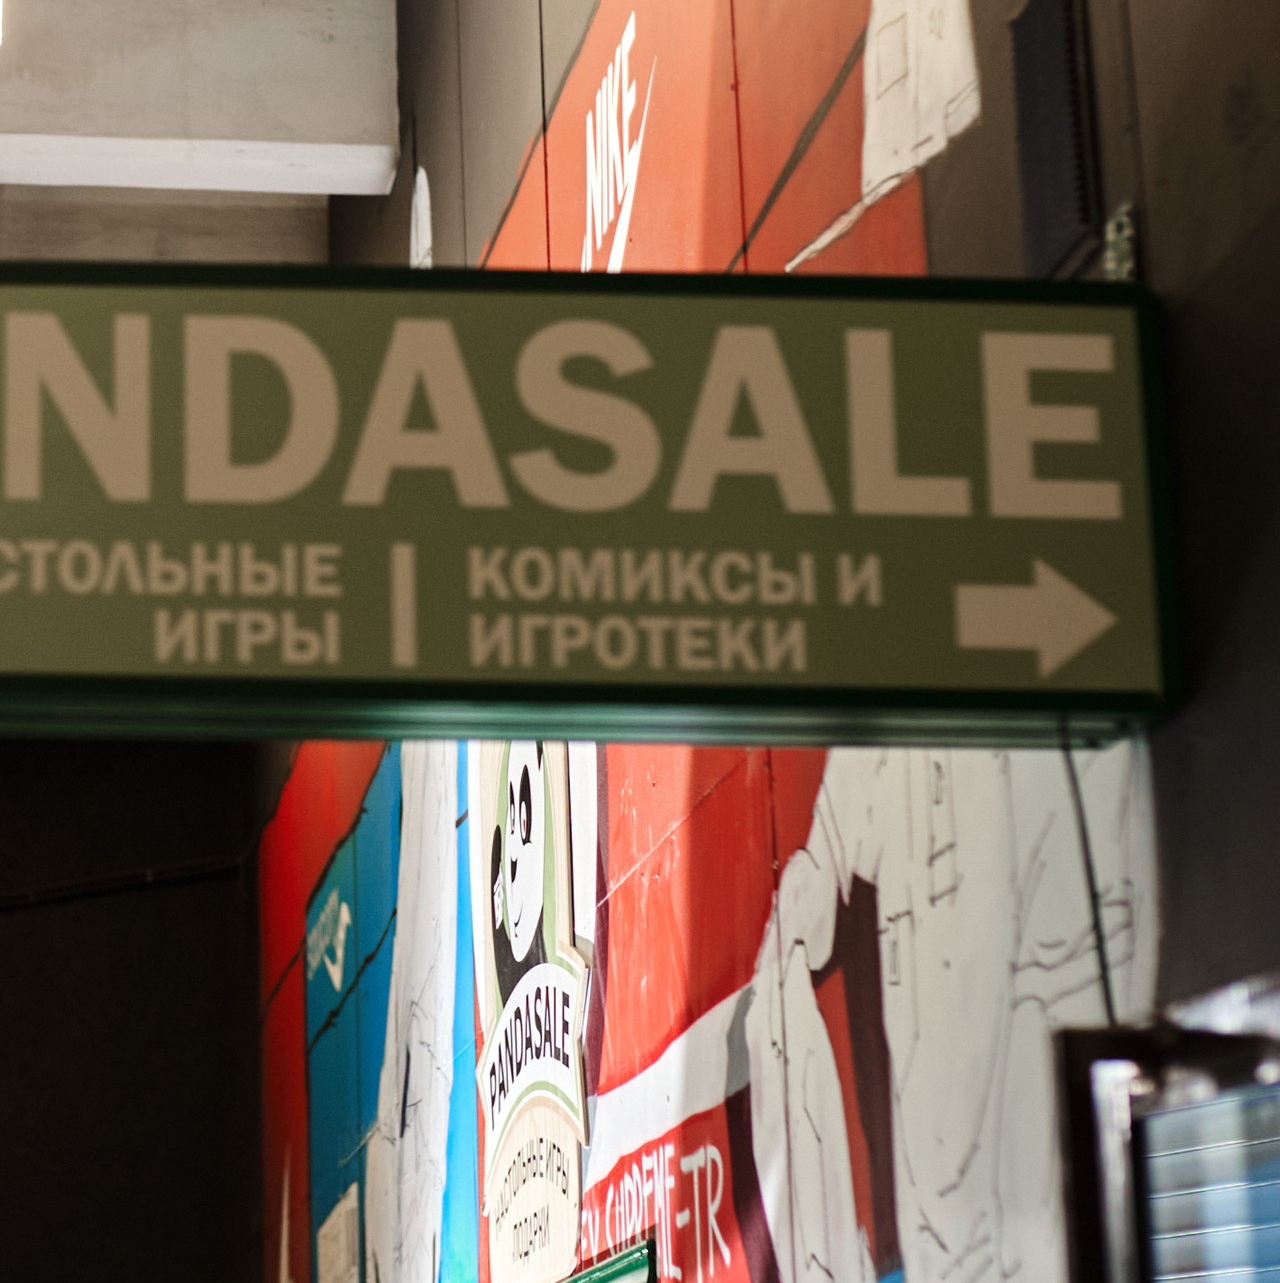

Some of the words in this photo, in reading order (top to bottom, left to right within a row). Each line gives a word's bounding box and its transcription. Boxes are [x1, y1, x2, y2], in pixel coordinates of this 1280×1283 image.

[467, 547, 816, 606] КОМИКСЫ
[838, 554, 884, 608] И
[154, 608, 341, 666] ИГРЫ
[470, 615, 808, 673] ИГРОТЕКИ
[490, 985, 570, 1132] PANDASALE
[495, 1136, 544, 1241] НАСТОЛЬНЫЕ
[545, 1138, 570, 1200] ИГРЫ
[513, 1203, 550, 1266] ПОДАРКИ
